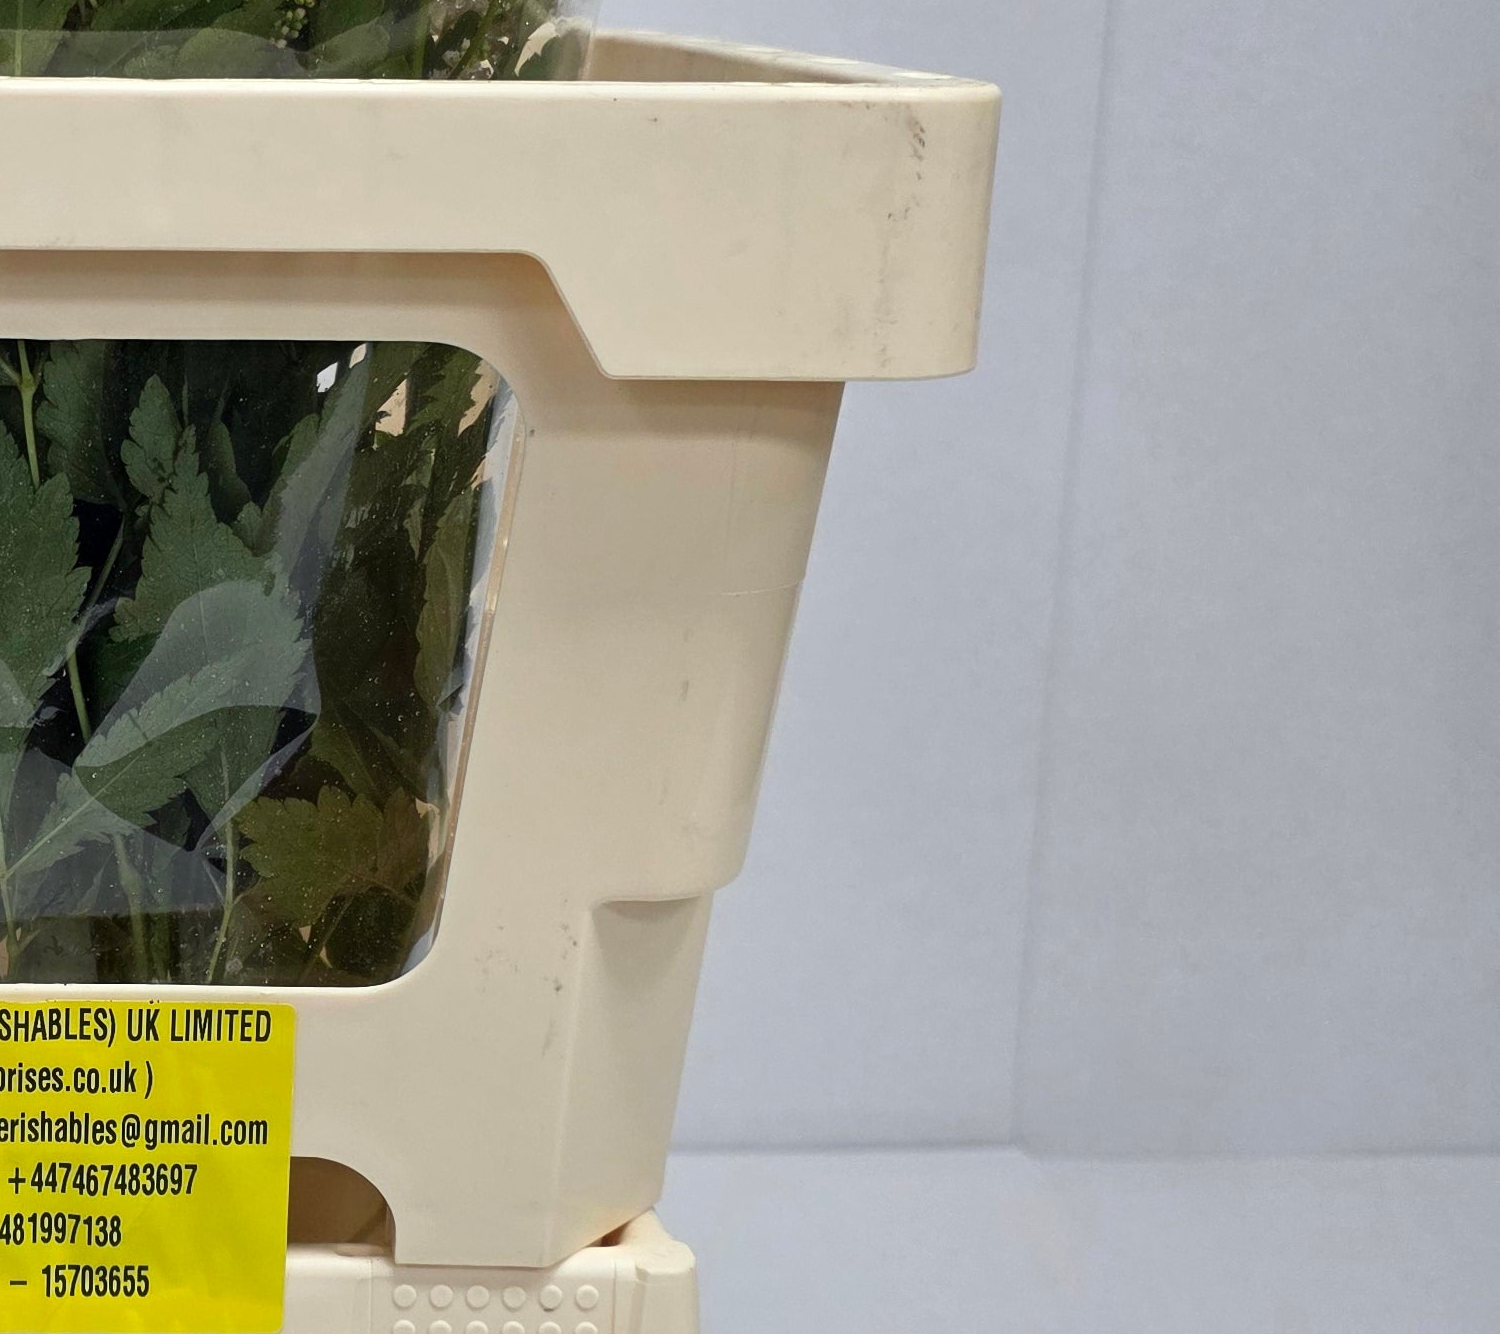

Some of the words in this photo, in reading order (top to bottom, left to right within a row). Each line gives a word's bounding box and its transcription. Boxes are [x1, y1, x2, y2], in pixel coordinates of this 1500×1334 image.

[127, 1008, 160, 1042] UK
[170, 1008, 272, 1042] LIMITED
[7, 1161, 198, 1197] +447467483697
[41, 1264, 150, 1298] 15703655
